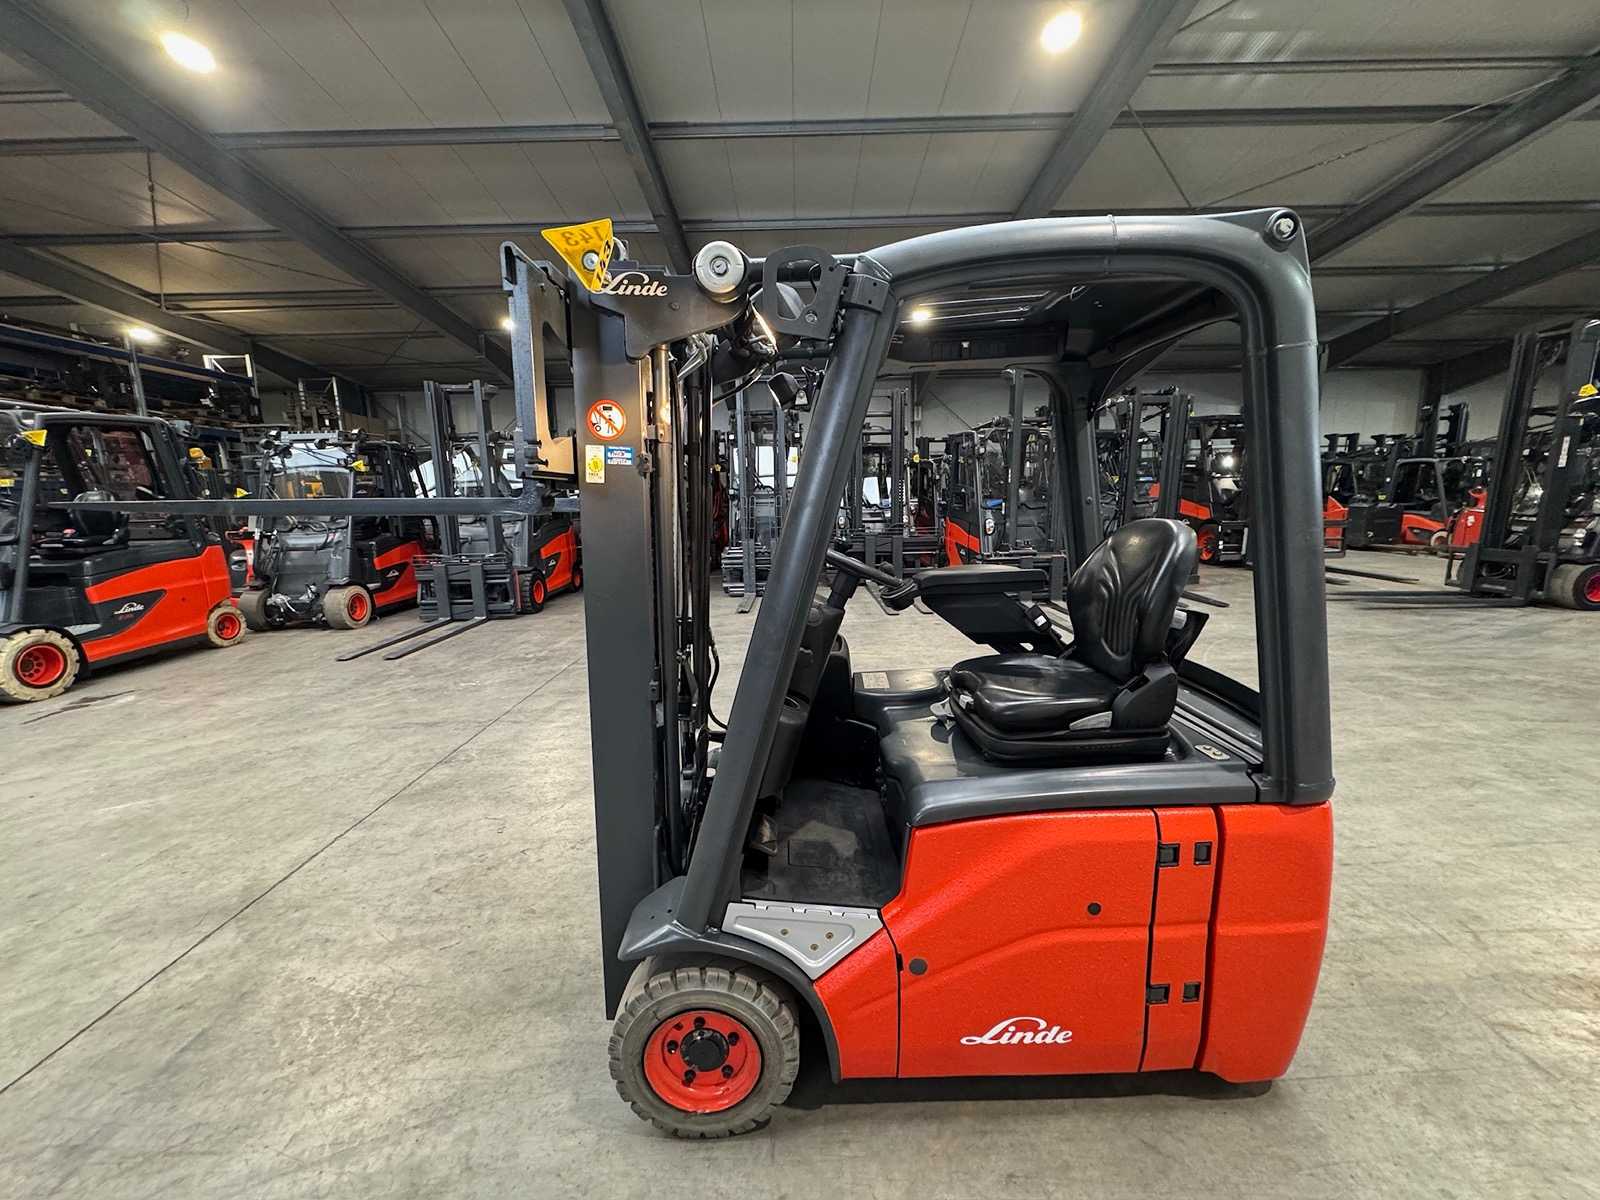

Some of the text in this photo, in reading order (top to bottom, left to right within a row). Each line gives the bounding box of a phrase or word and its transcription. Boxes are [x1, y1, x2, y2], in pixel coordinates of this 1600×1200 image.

[602, 271, 668, 297] Linde
[113, 602, 145, 615] Linde
[960, 1016, 1073, 1045] Linde
